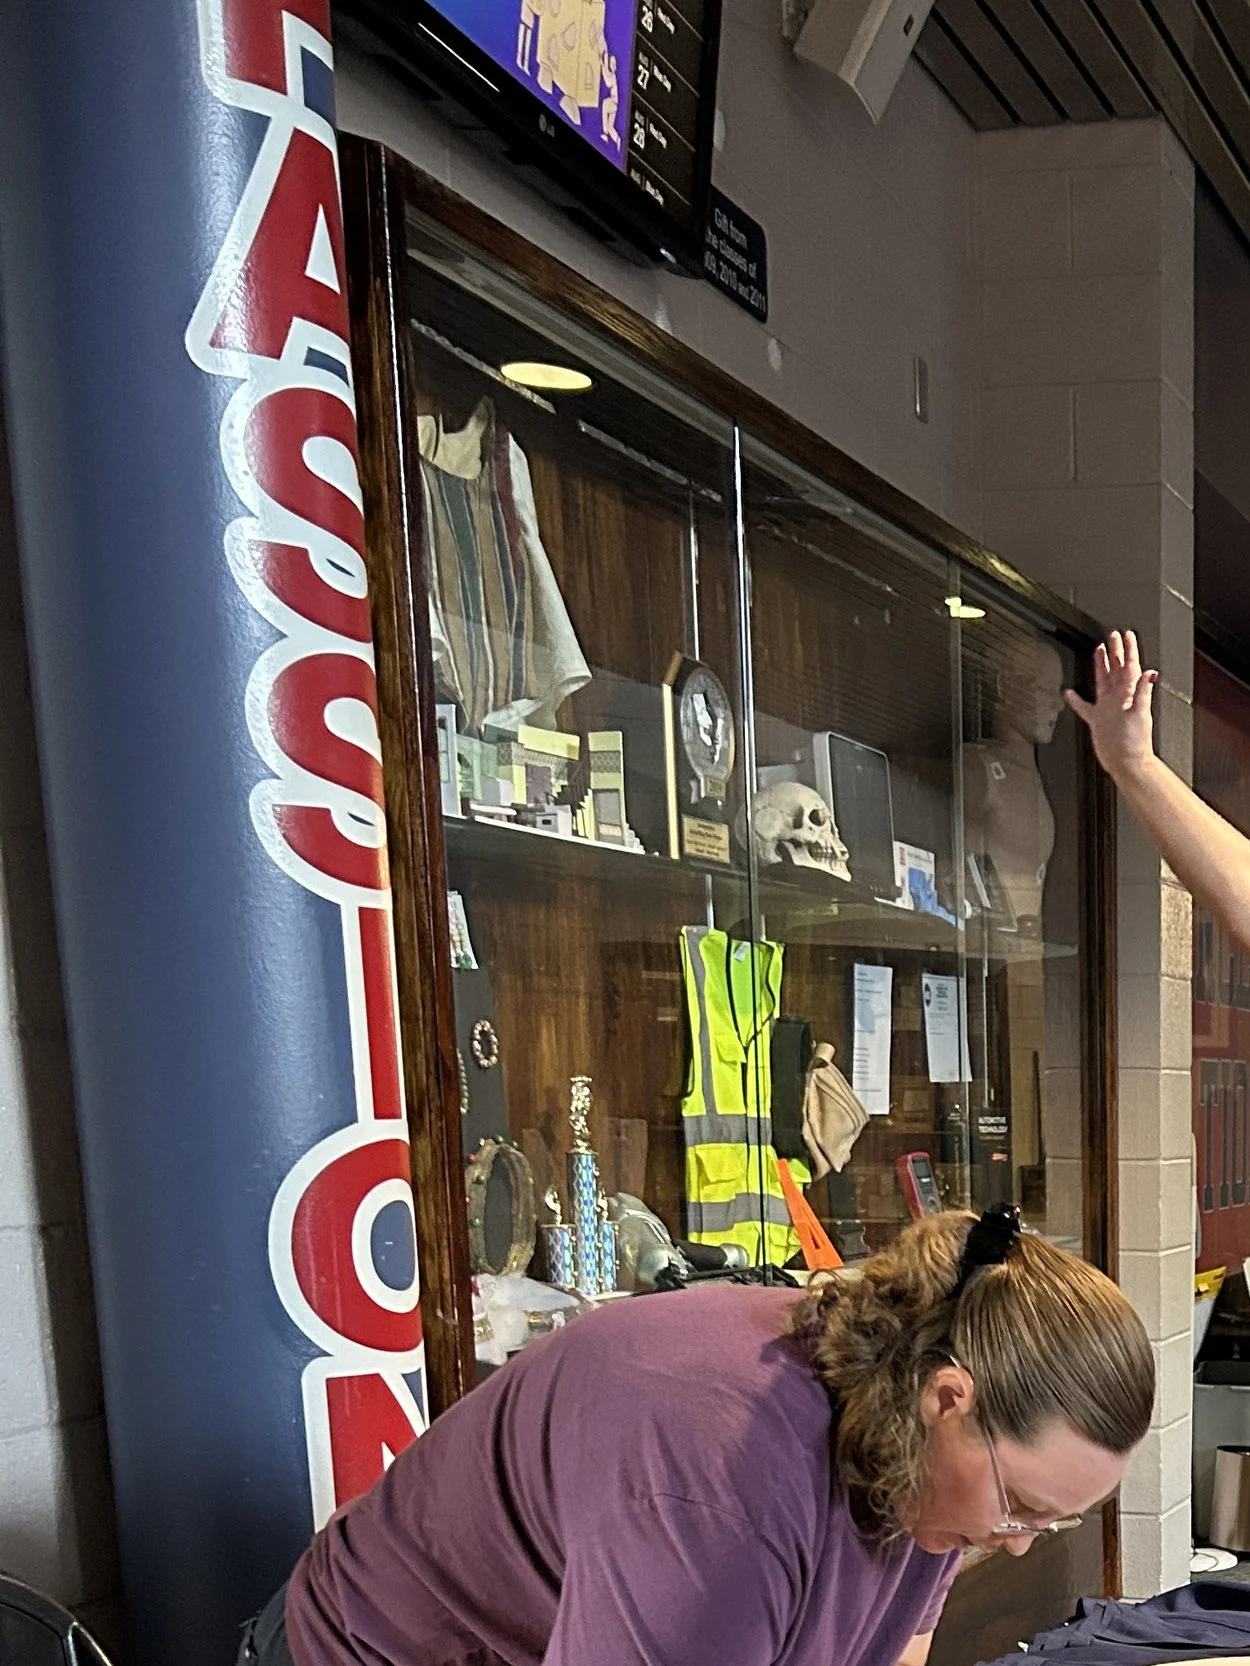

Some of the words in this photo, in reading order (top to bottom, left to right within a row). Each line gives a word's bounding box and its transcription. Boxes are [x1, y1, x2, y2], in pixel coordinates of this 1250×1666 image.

[641, 5, 653, 33] 26
[637, 64, 650, 90] 27
[633, 122, 645, 149] 28
[714, 208, 729, 236] Gift
[729, 219, 748, 250] from
[719, 238, 748, 274] classes
[748, 262, 757, 280] of
[719, 261, 738, 291] 2010
